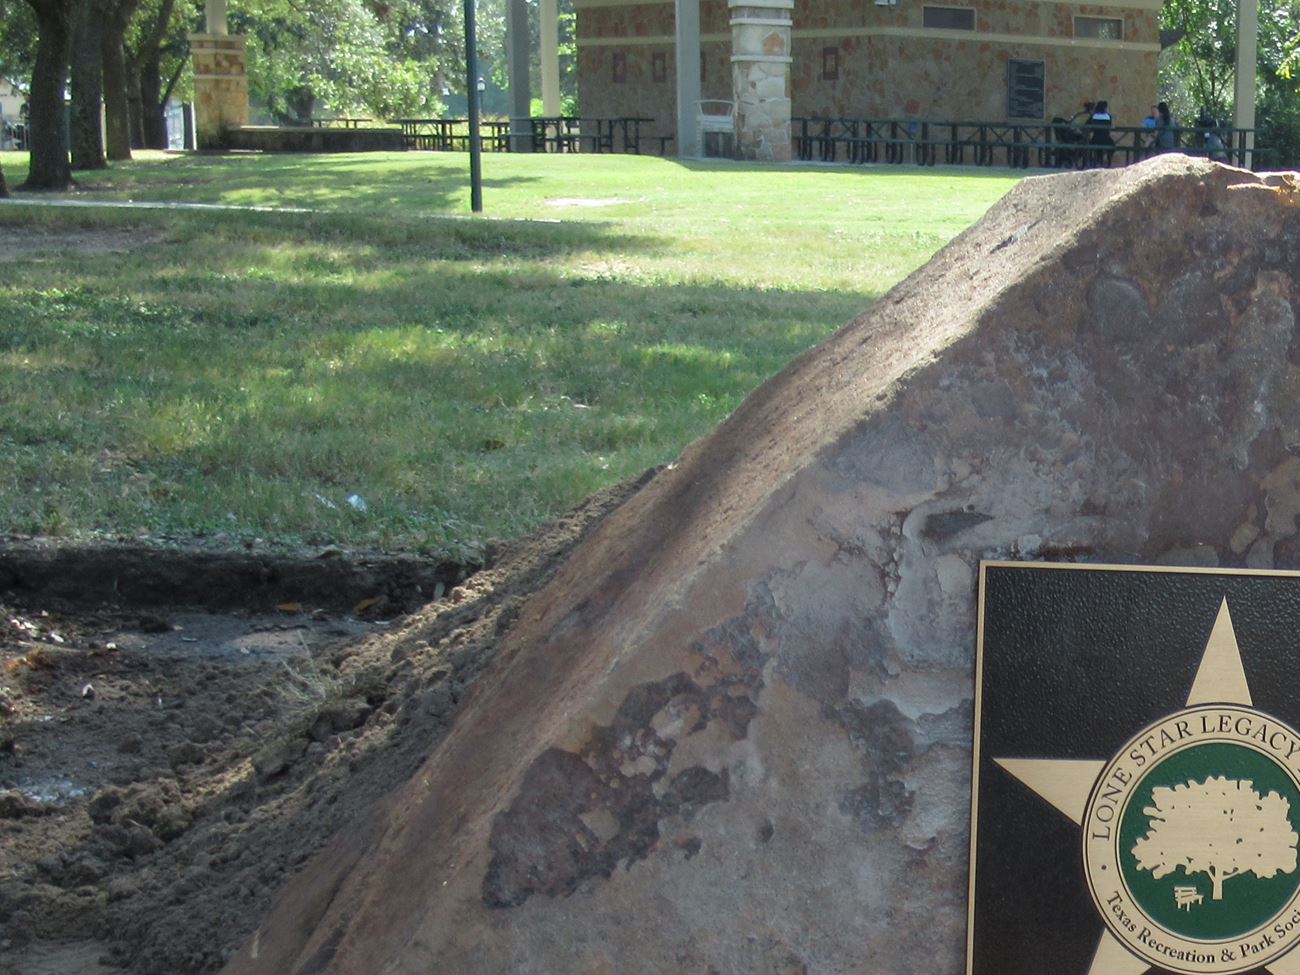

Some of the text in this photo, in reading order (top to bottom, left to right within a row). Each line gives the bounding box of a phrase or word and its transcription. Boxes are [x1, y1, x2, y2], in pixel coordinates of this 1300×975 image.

[1092, 767, 1132, 841] LONE
[1130, 720, 1193, 767] STAR
[1106, 891, 1137, 934] Texas
[1137, 929, 1216, 964] Recreation
[1220, 949, 1237, 962] &
[1239, 932, 1274, 957] Park
